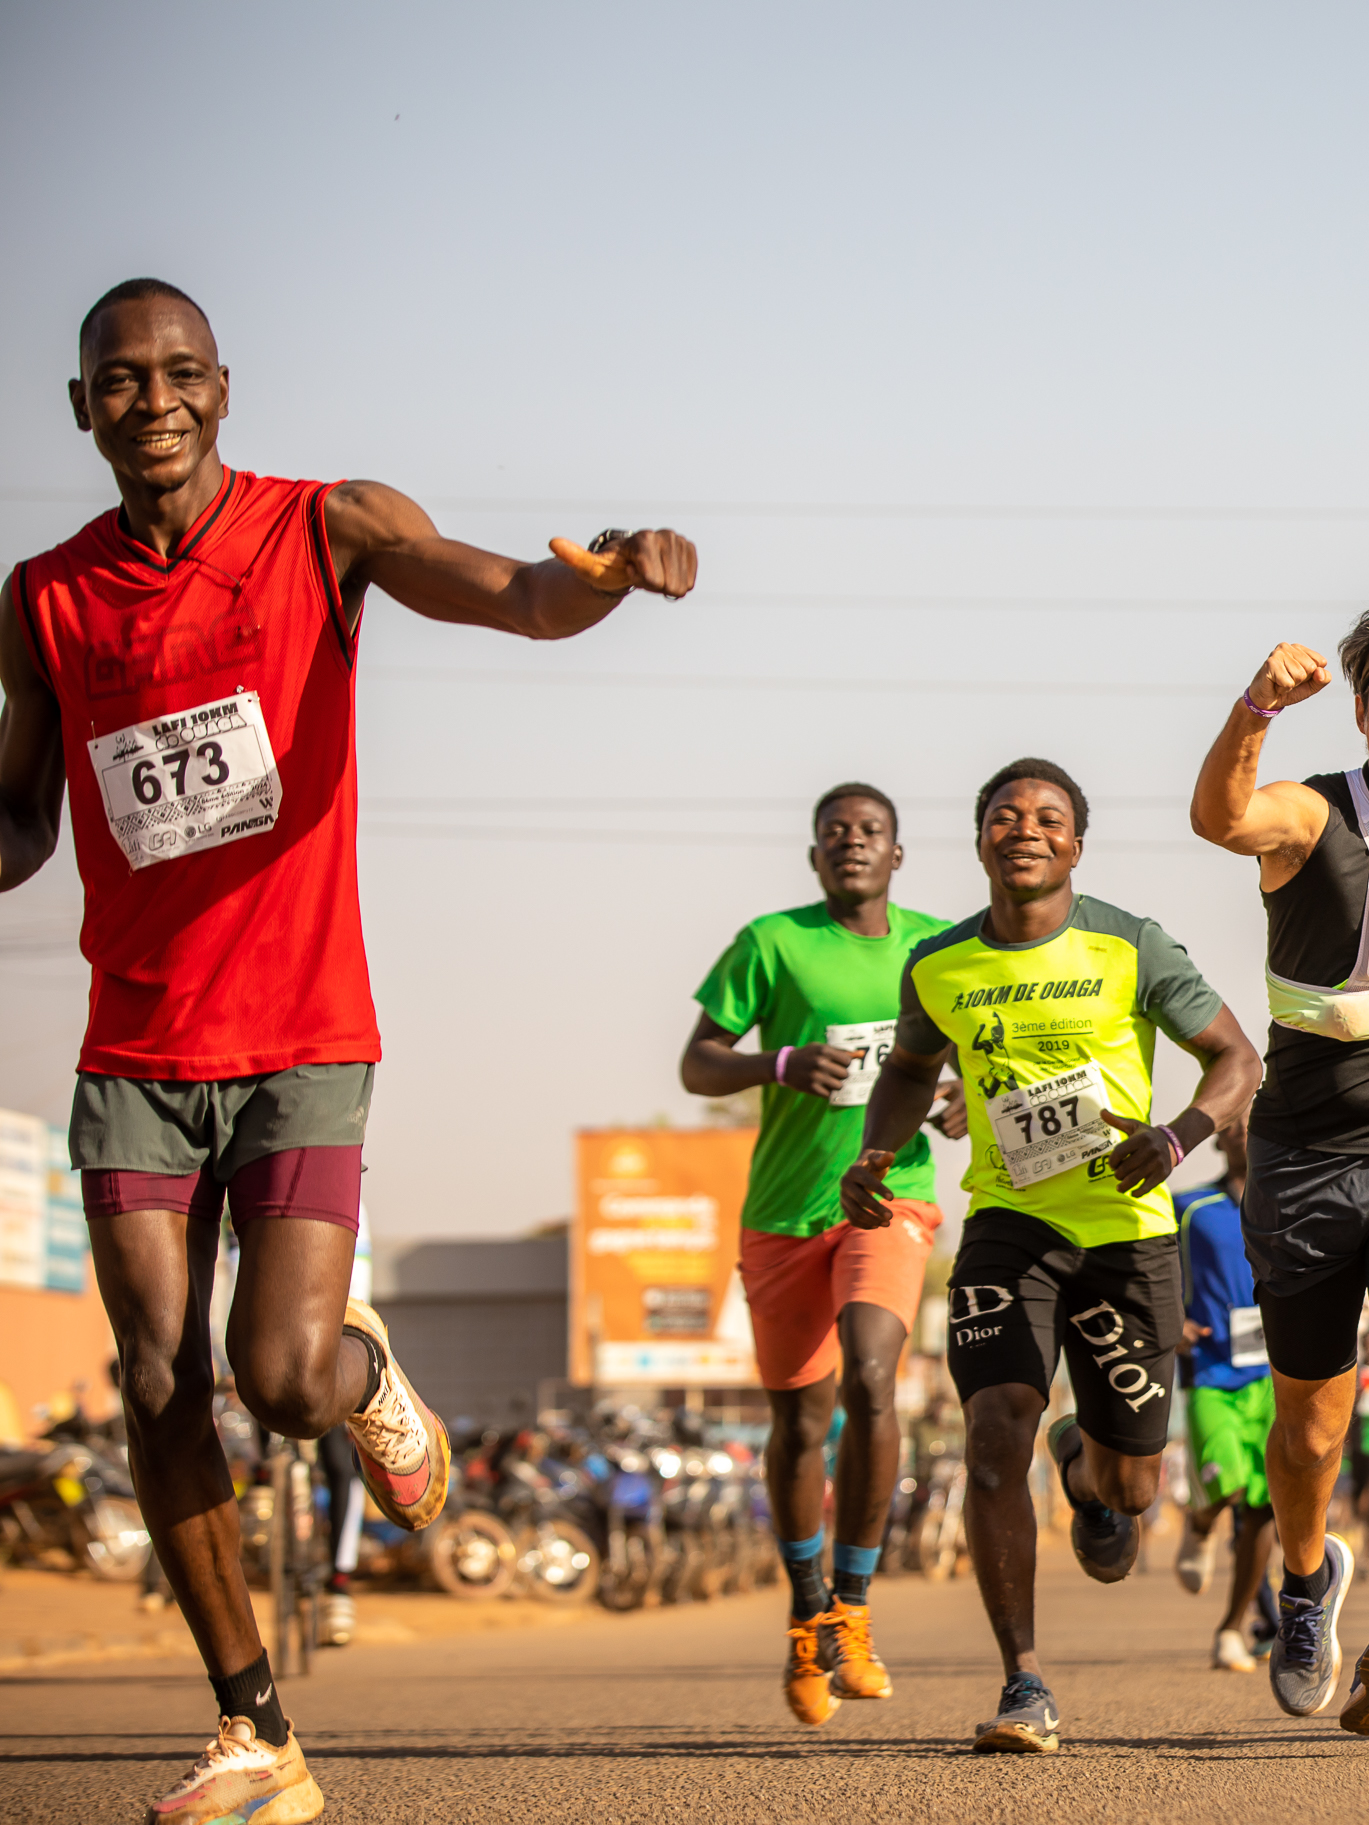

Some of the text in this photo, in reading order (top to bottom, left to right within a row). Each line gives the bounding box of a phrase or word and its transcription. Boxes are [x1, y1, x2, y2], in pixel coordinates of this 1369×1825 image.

[152, 702, 239, 737] LAFI 10KM
[180, 713, 248, 743] OUAGA
[131, 741, 230, 805] 673
[198, 822, 212, 834] LG
[963, 978, 1104, 1009] 10KM DE OUAGA
[1011, 1018, 1093, 1033] 3ème édition
[855, 1043, 890, 1071] 76
[1037, 1039, 1070, 1052] 2019
[1027, 1070, 1087, 1097] LAFI 10KM
[1047, 1077, 1093, 1100] OUAGA
[1014, 1095, 1079, 1144] 787
[1065, 1149, 1076, 1159] LG
[956, 1324, 1004, 1346] Dior
[1069, 1299, 1166, 1413] Dior
